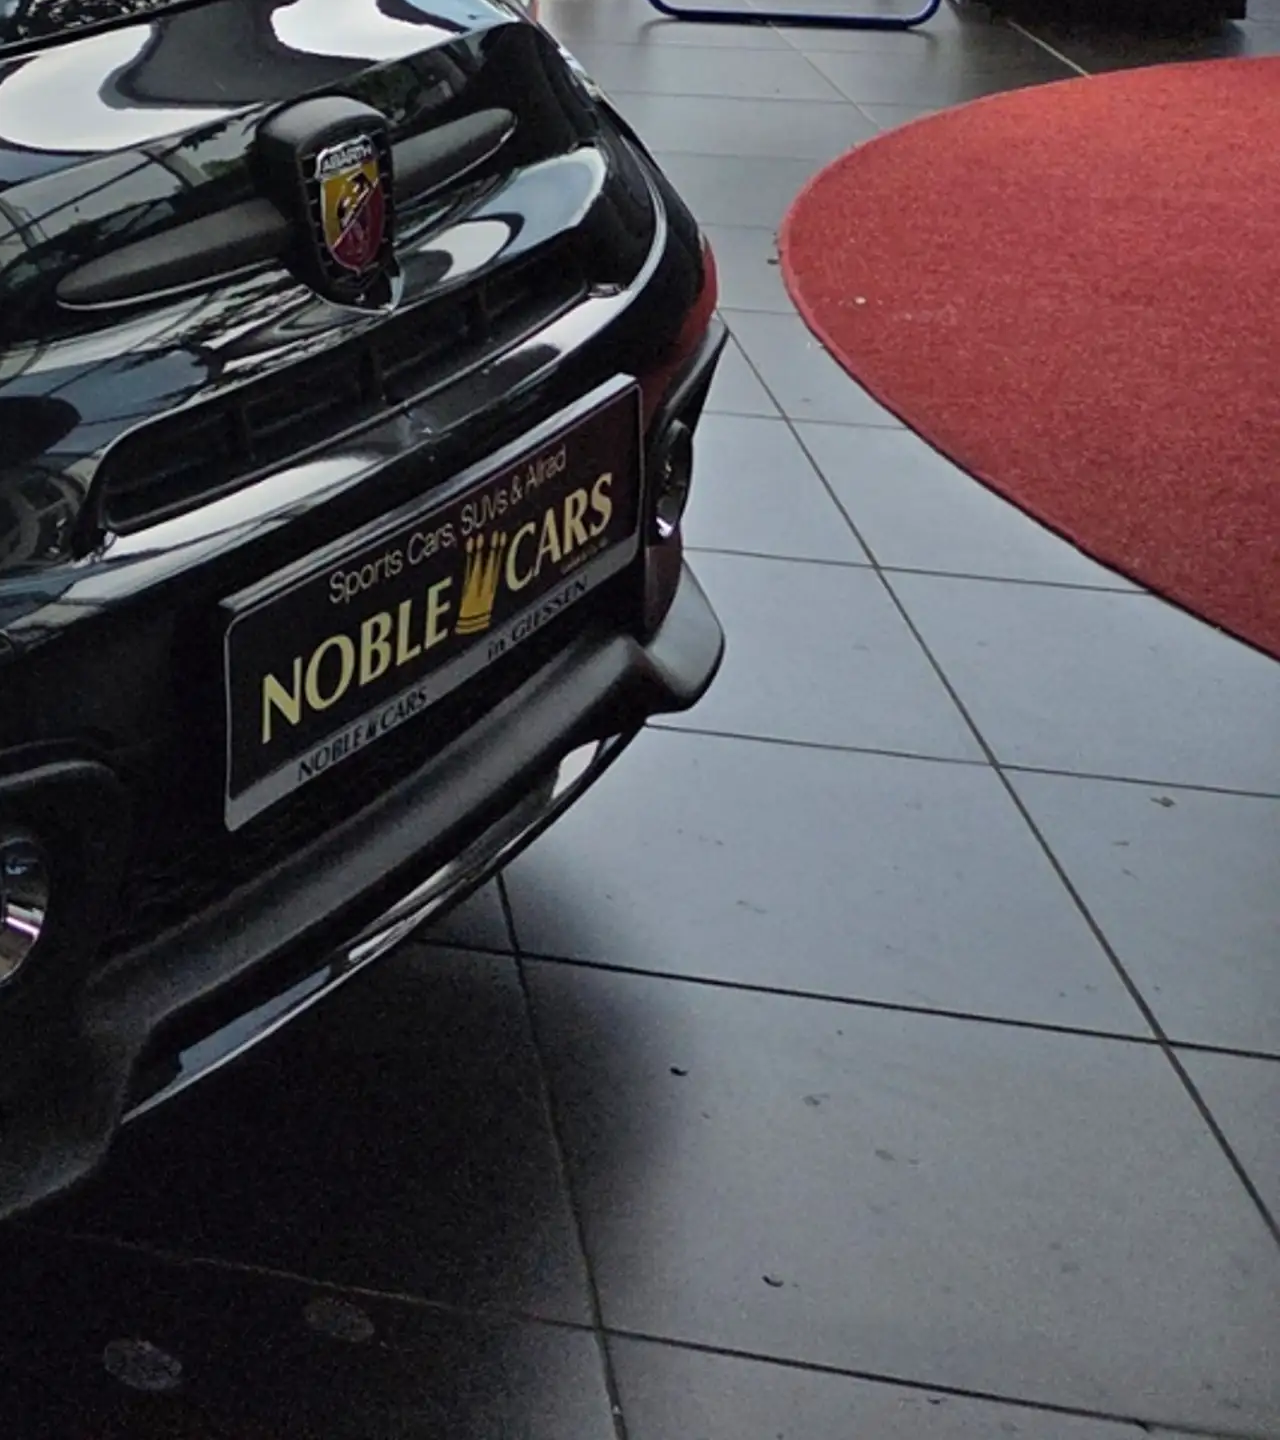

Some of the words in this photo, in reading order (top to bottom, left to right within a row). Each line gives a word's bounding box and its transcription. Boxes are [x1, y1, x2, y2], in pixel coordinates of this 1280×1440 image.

[328, 547, 403, 605] Sports
[460, 488, 508, 537] SUVs
[510, 474, 525, 505] &
[525, 443, 568, 496] Allrad
[261, 576, 453, 745] NOBLE
[505, 472, 614, 593] CARS
[297, 725, 363, 781] NOBLE
[380, 685, 427, 731] CARS
